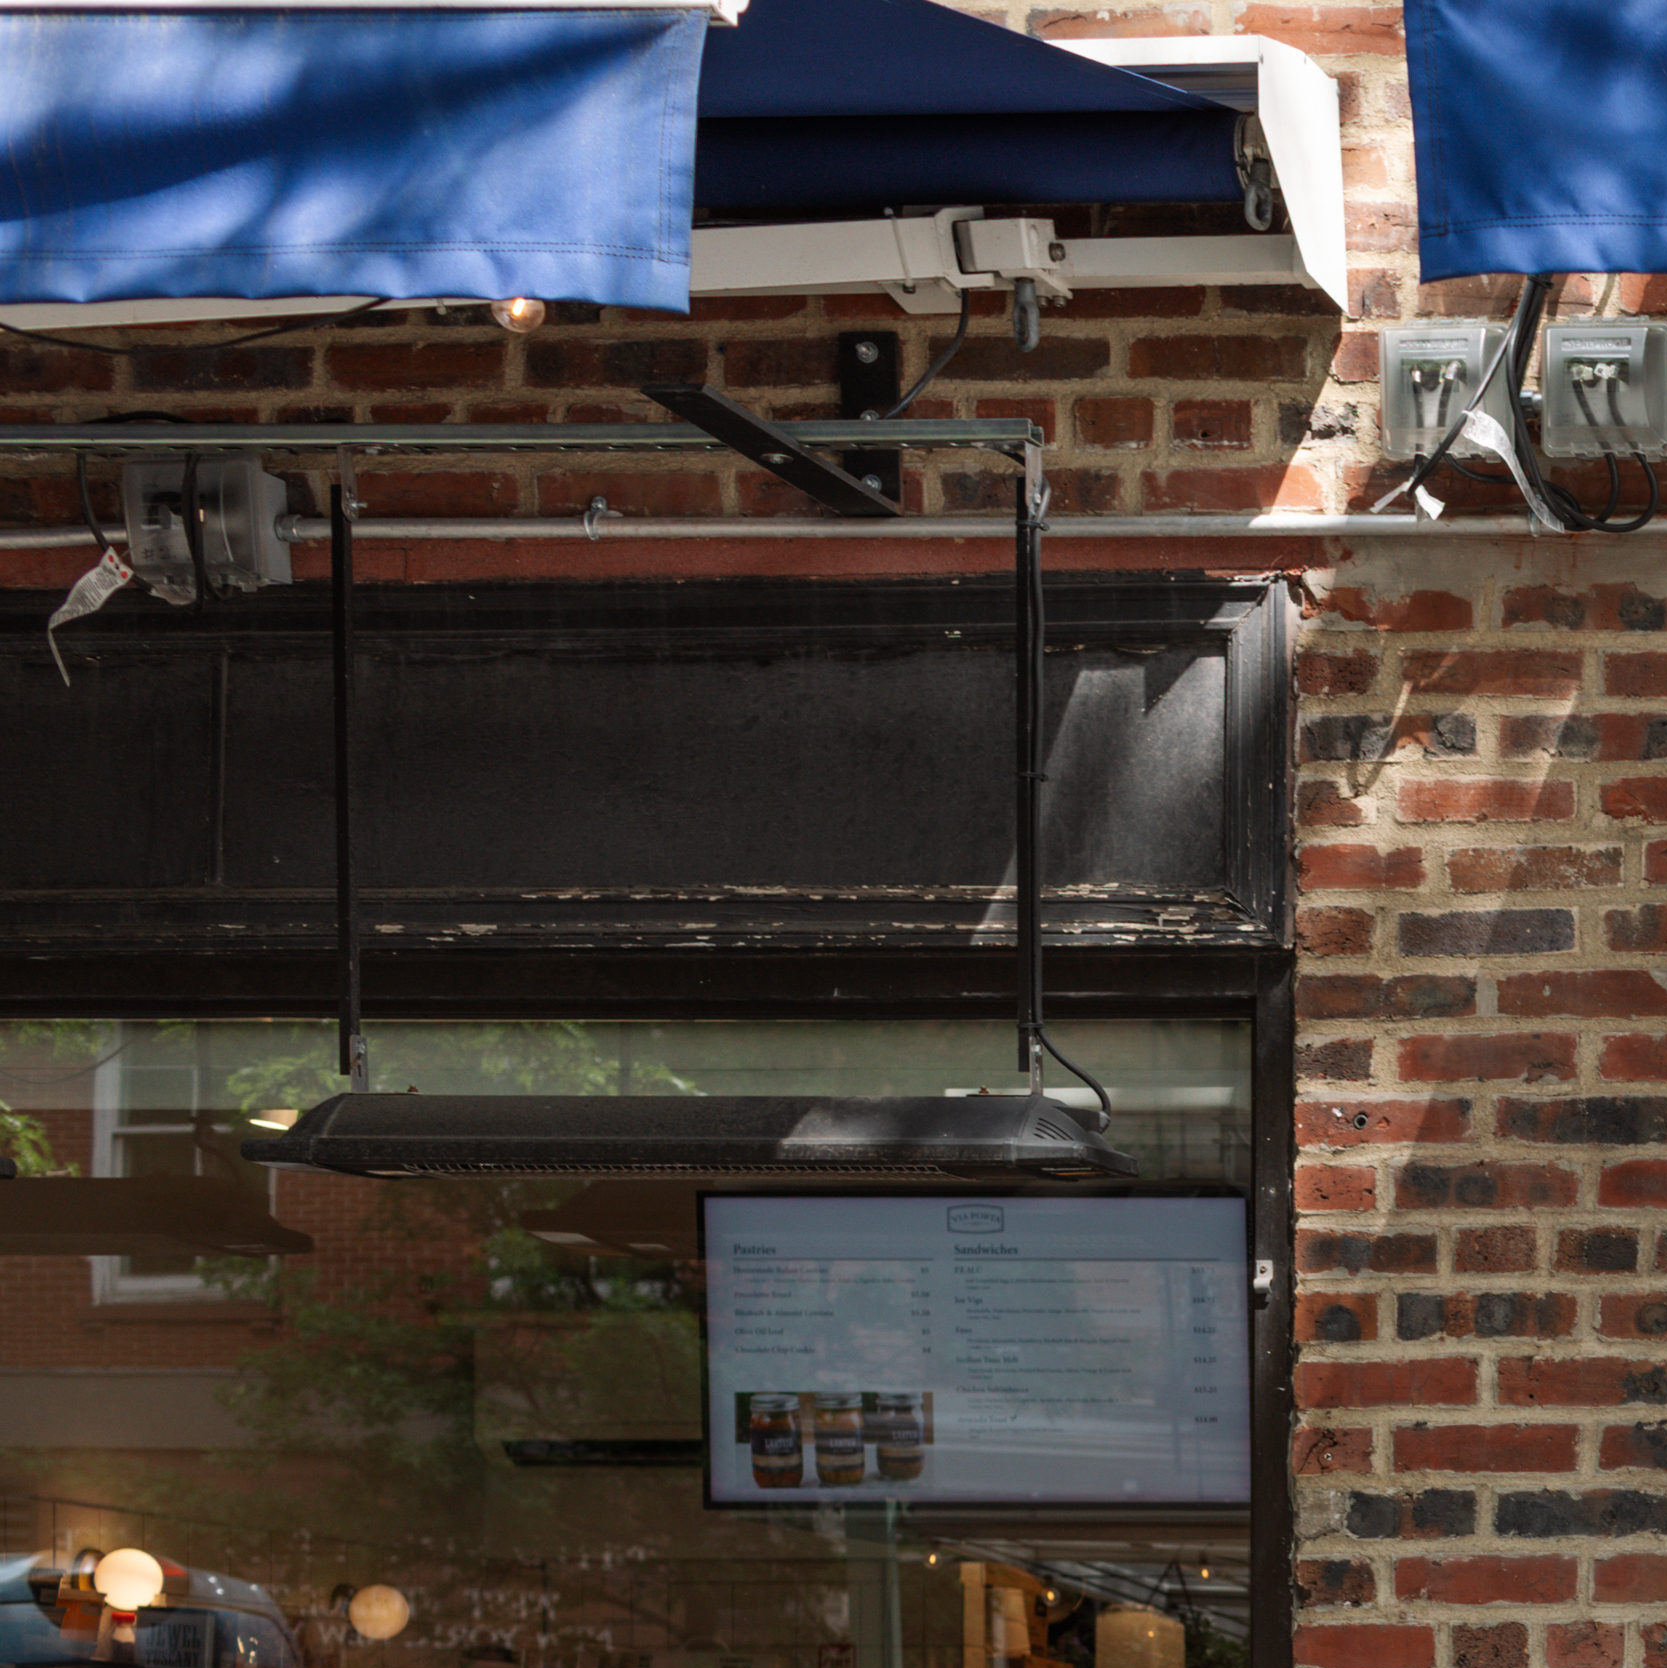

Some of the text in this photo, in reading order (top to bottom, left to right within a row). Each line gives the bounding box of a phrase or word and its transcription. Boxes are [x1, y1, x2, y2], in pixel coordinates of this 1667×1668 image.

[970, 1212, 1002, 1224] PORTA
[733, 1244, 776, 1255] Pastries
[954, 1244, 1018, 1255] Sandwiches
[735, 1346, 770, 1354] Chocolate
[771, 1346, 789, 1355] Chip
[956, 1385, 986, 1393] Chicken
